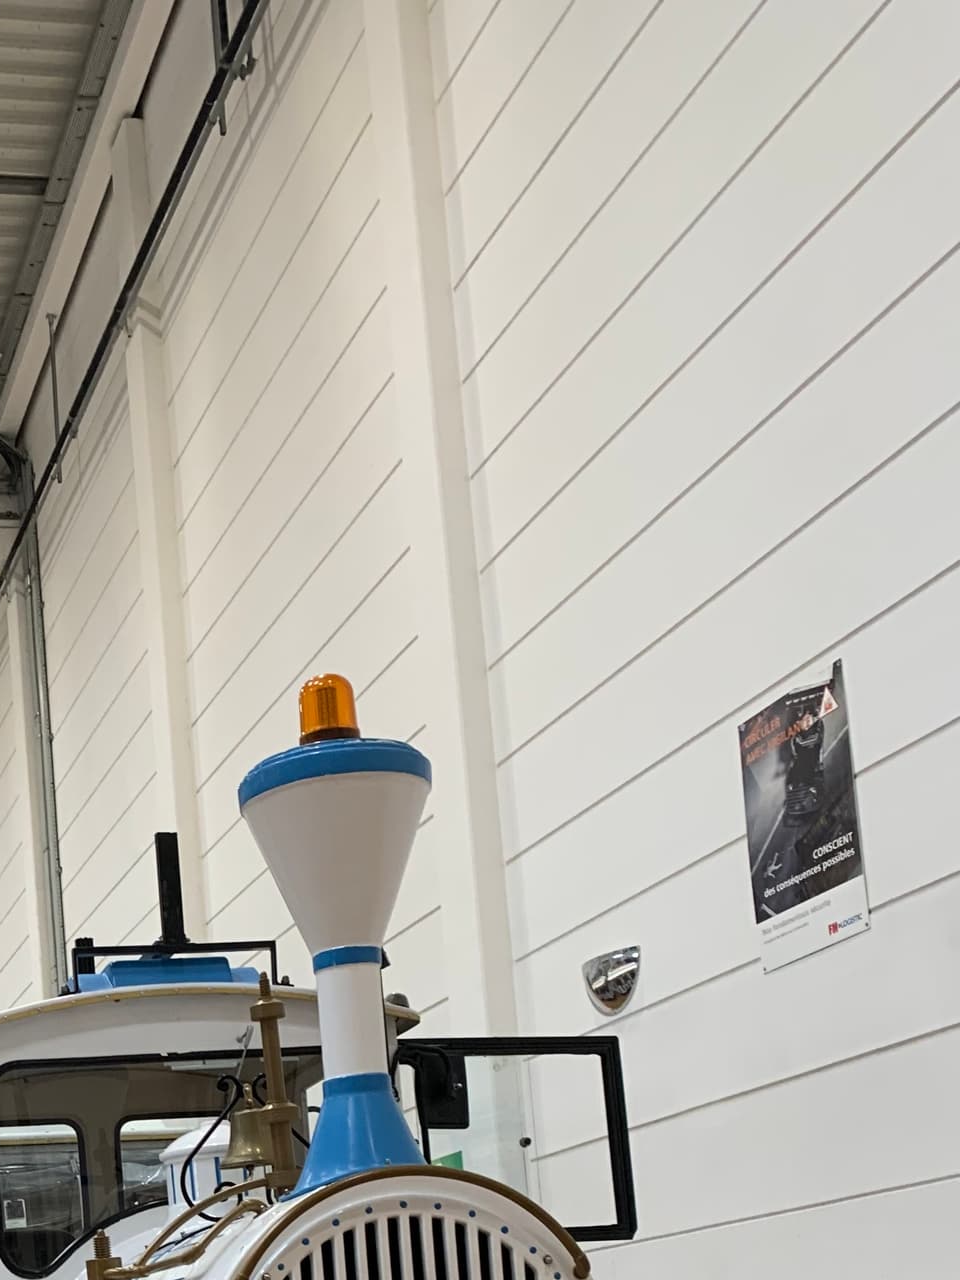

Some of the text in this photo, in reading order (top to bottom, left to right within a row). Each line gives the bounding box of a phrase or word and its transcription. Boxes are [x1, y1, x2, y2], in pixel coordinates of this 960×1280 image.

[813, 831, 854, 860] CONSCIENT
[764, 847, 856, 898] des conséquences possibles
